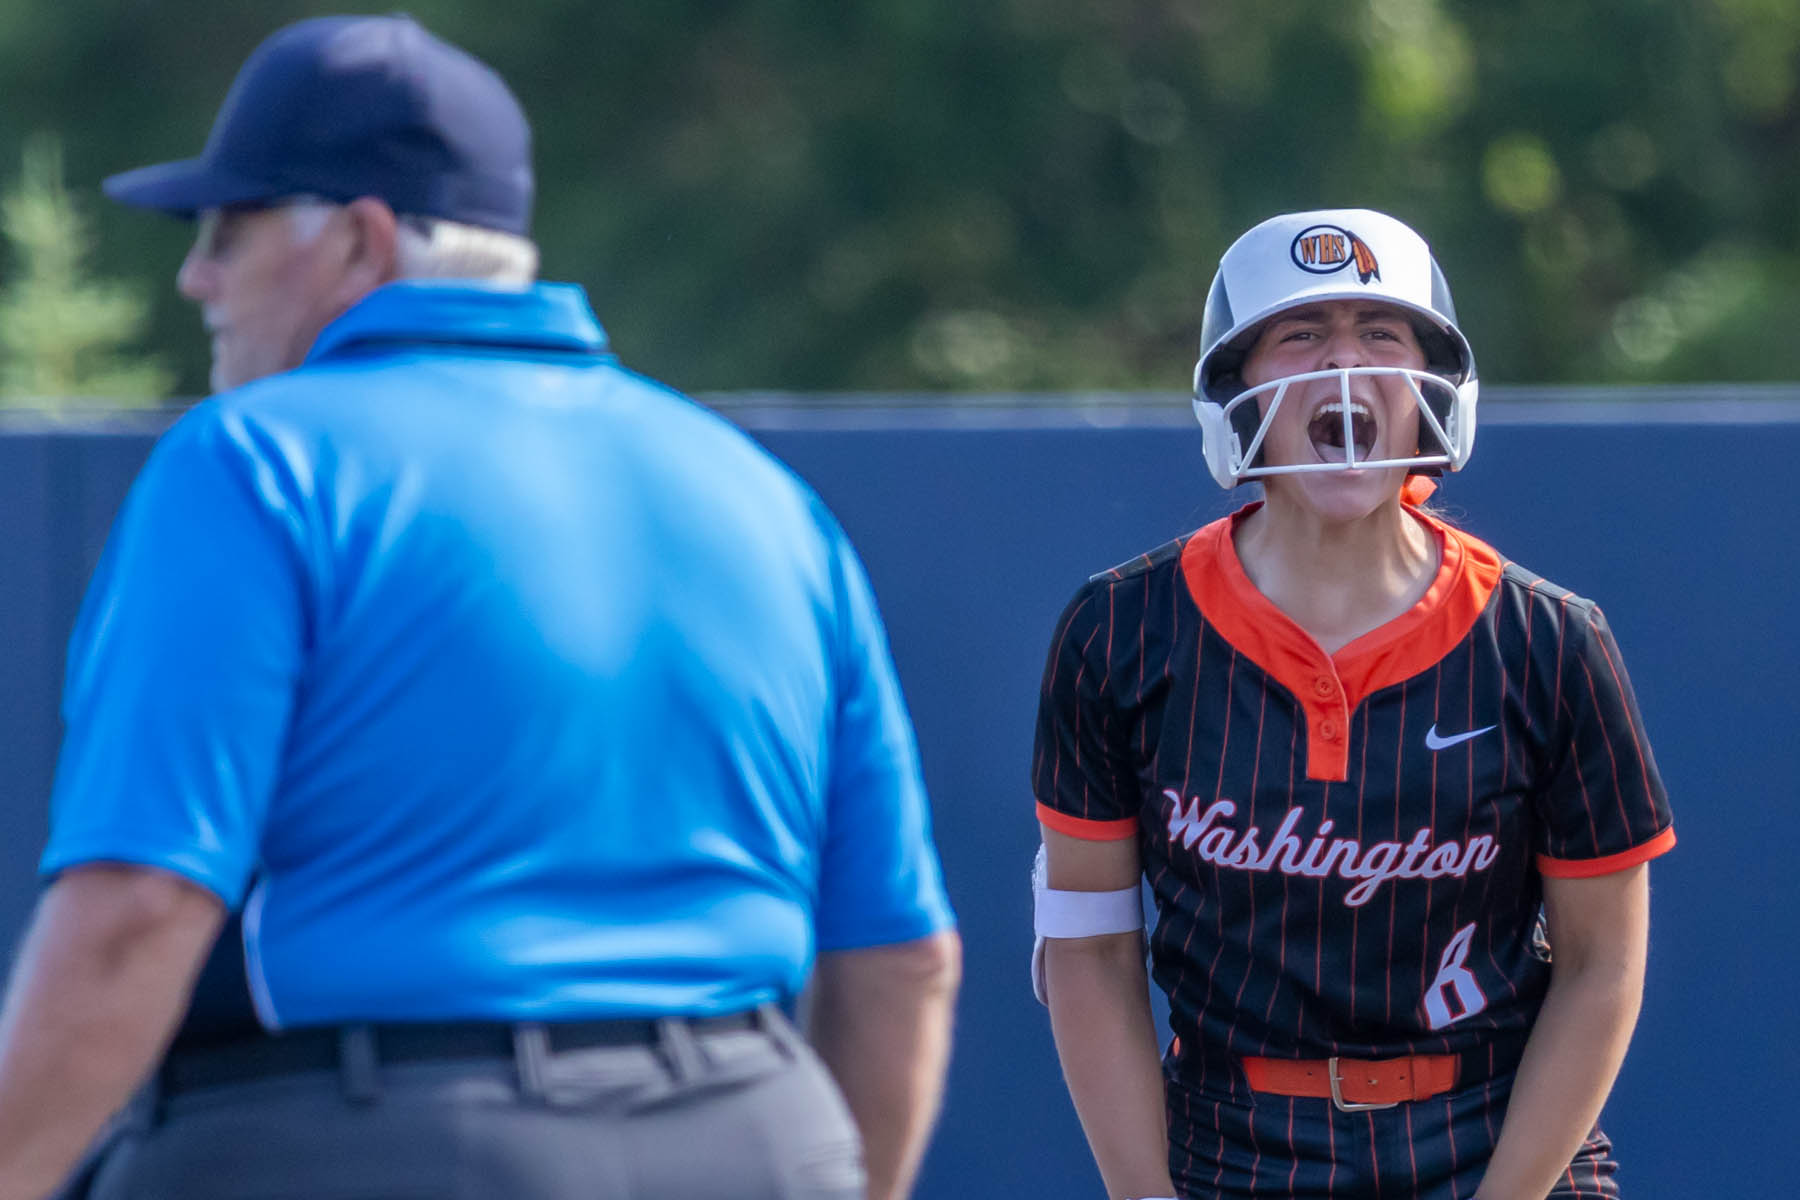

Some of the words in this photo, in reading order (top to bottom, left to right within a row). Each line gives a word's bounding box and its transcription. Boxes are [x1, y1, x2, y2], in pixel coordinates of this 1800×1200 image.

[1299, 233, 1346, 264] WHS
[1162, 788, 1500, 907] Washington
[1423, 921, 1488, 1031] 8
